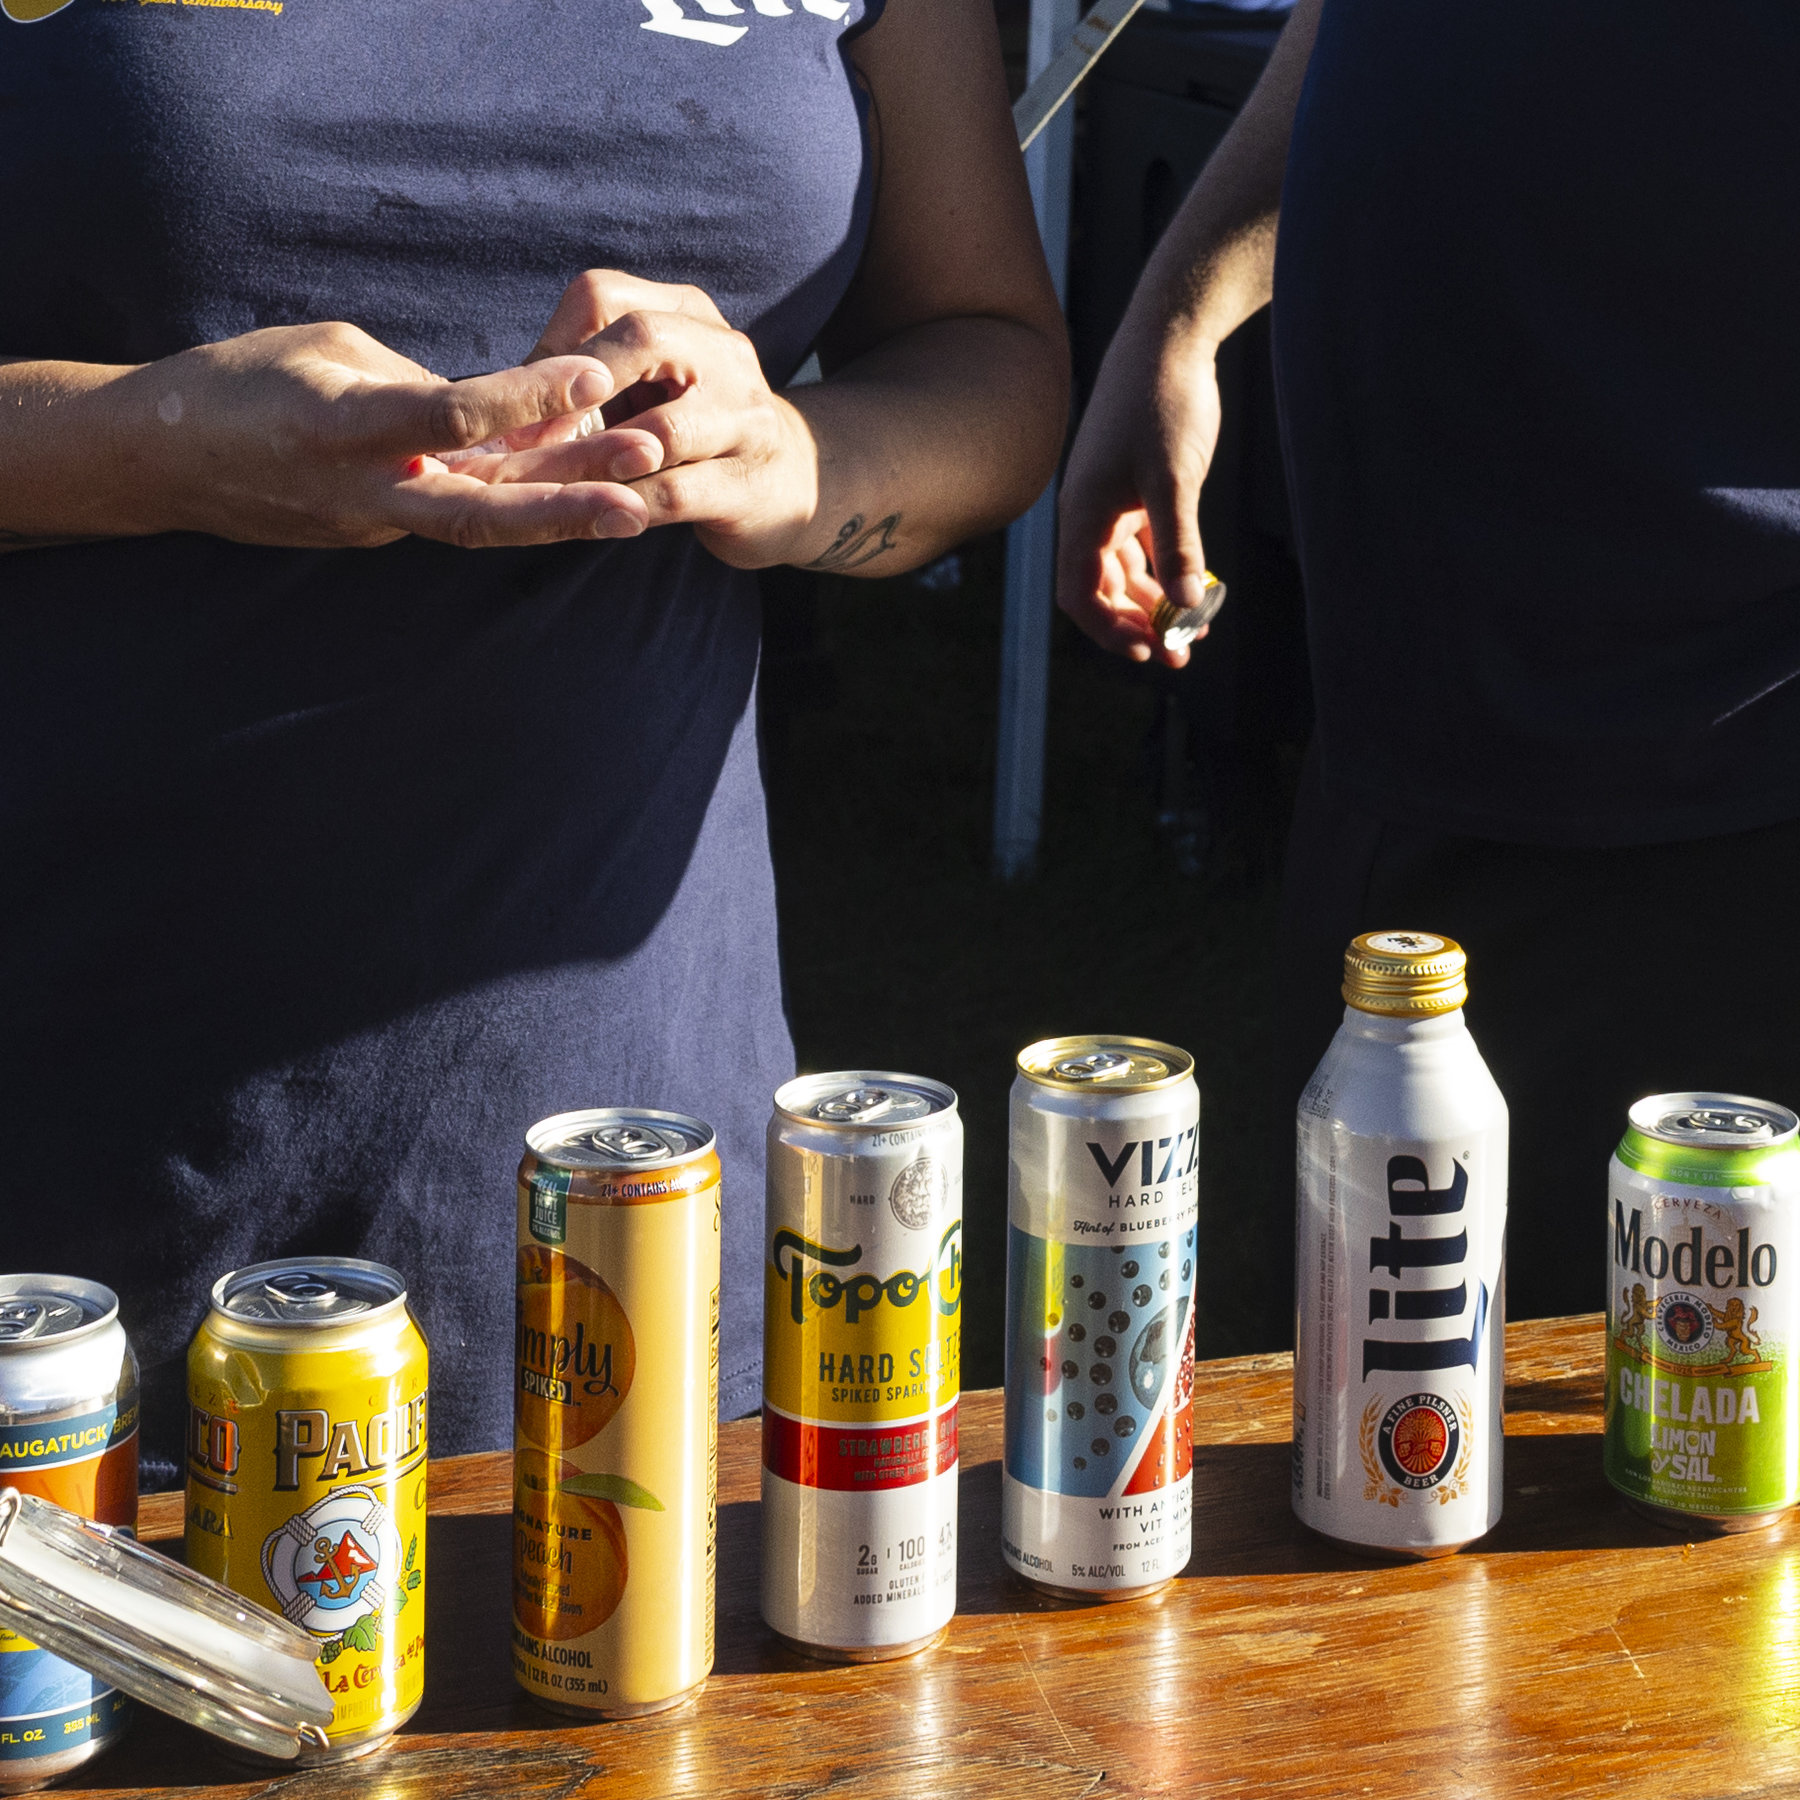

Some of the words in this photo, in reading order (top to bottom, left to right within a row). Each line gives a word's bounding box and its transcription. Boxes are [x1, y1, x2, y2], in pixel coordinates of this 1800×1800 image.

[601, 1184, 619, 1198] 21+
[621, 1180, 668, 1198] CONTAINS
[849, 1194, 876, 1206] HARD
[1108, 1190, 1164, 1209] HARD
[534, 1208, 558, 1225] JUICE
[1653, 1197, 1723, 1221] CERVEZA
[1073, 1219, 1102, 1235] Hint
[1102, 1221, 1116, 1236] of
[1614, 1197, 1778, 1290] Modelo
[773, 1226, 922, 1325] Topo
[1362, 1154, 1490, 1384] Lite
[1694, 1299, 1714, 1340] MODELO
[818, 1351, 895, 1384] HARD
[523, 1370, 568, 1402] SPIKED
[831, 1386, 881, 1404] SPIKED
[1619, 1366, 1761, 1425] CHELADA
[1382, 1425, 1392, 1435] A
[1387, 1397, 1415, 1423] FINE
[1418, 1395, 1458, 1433] PILSNER
[272, 1388, 428, 1492] PACIF
[838, 1429, 929, 1457] STRAWBERR
[1651, 1423, 1717, 1457] LIMON
[1403, 1473, 1439, 1488] BEER
[1668, 1454, 1717, 1483] SAL
[1099, 1504, 1143, 1520] WITH
[1140, 1508, 1188, 1533] VITMIN
[518, 1529, 573, 1575] Peach
[898, 1535, 925, 1562] 100
[1112, 1541, 1141, 1552] FROM
[1022, 1551, 1055, 1573] ALCOHOL
[1071, 1564, 1087, 1577] 5%
[1088, 1564, 1126, 1577] ALC/VOL
[853, 1593, 883, 1605] ADDED
[886, 1584, 925, 1602] MINERAL
[888, 1574, 919, 1590] GLUTEN
[540, 1642, 594, 1669] ALCOHOL
[322, 1671, 350, 1694] La
[551, 1674, 563, 1690] OZ
[564, 1677, 586, 1693] (355
[588, 1680, 609, 1695] mL)
[22, 1728, 46, 1743] OZ.
[63, 1720, 85, 1734] 355
[85, 1712, 101, 1726] ML
